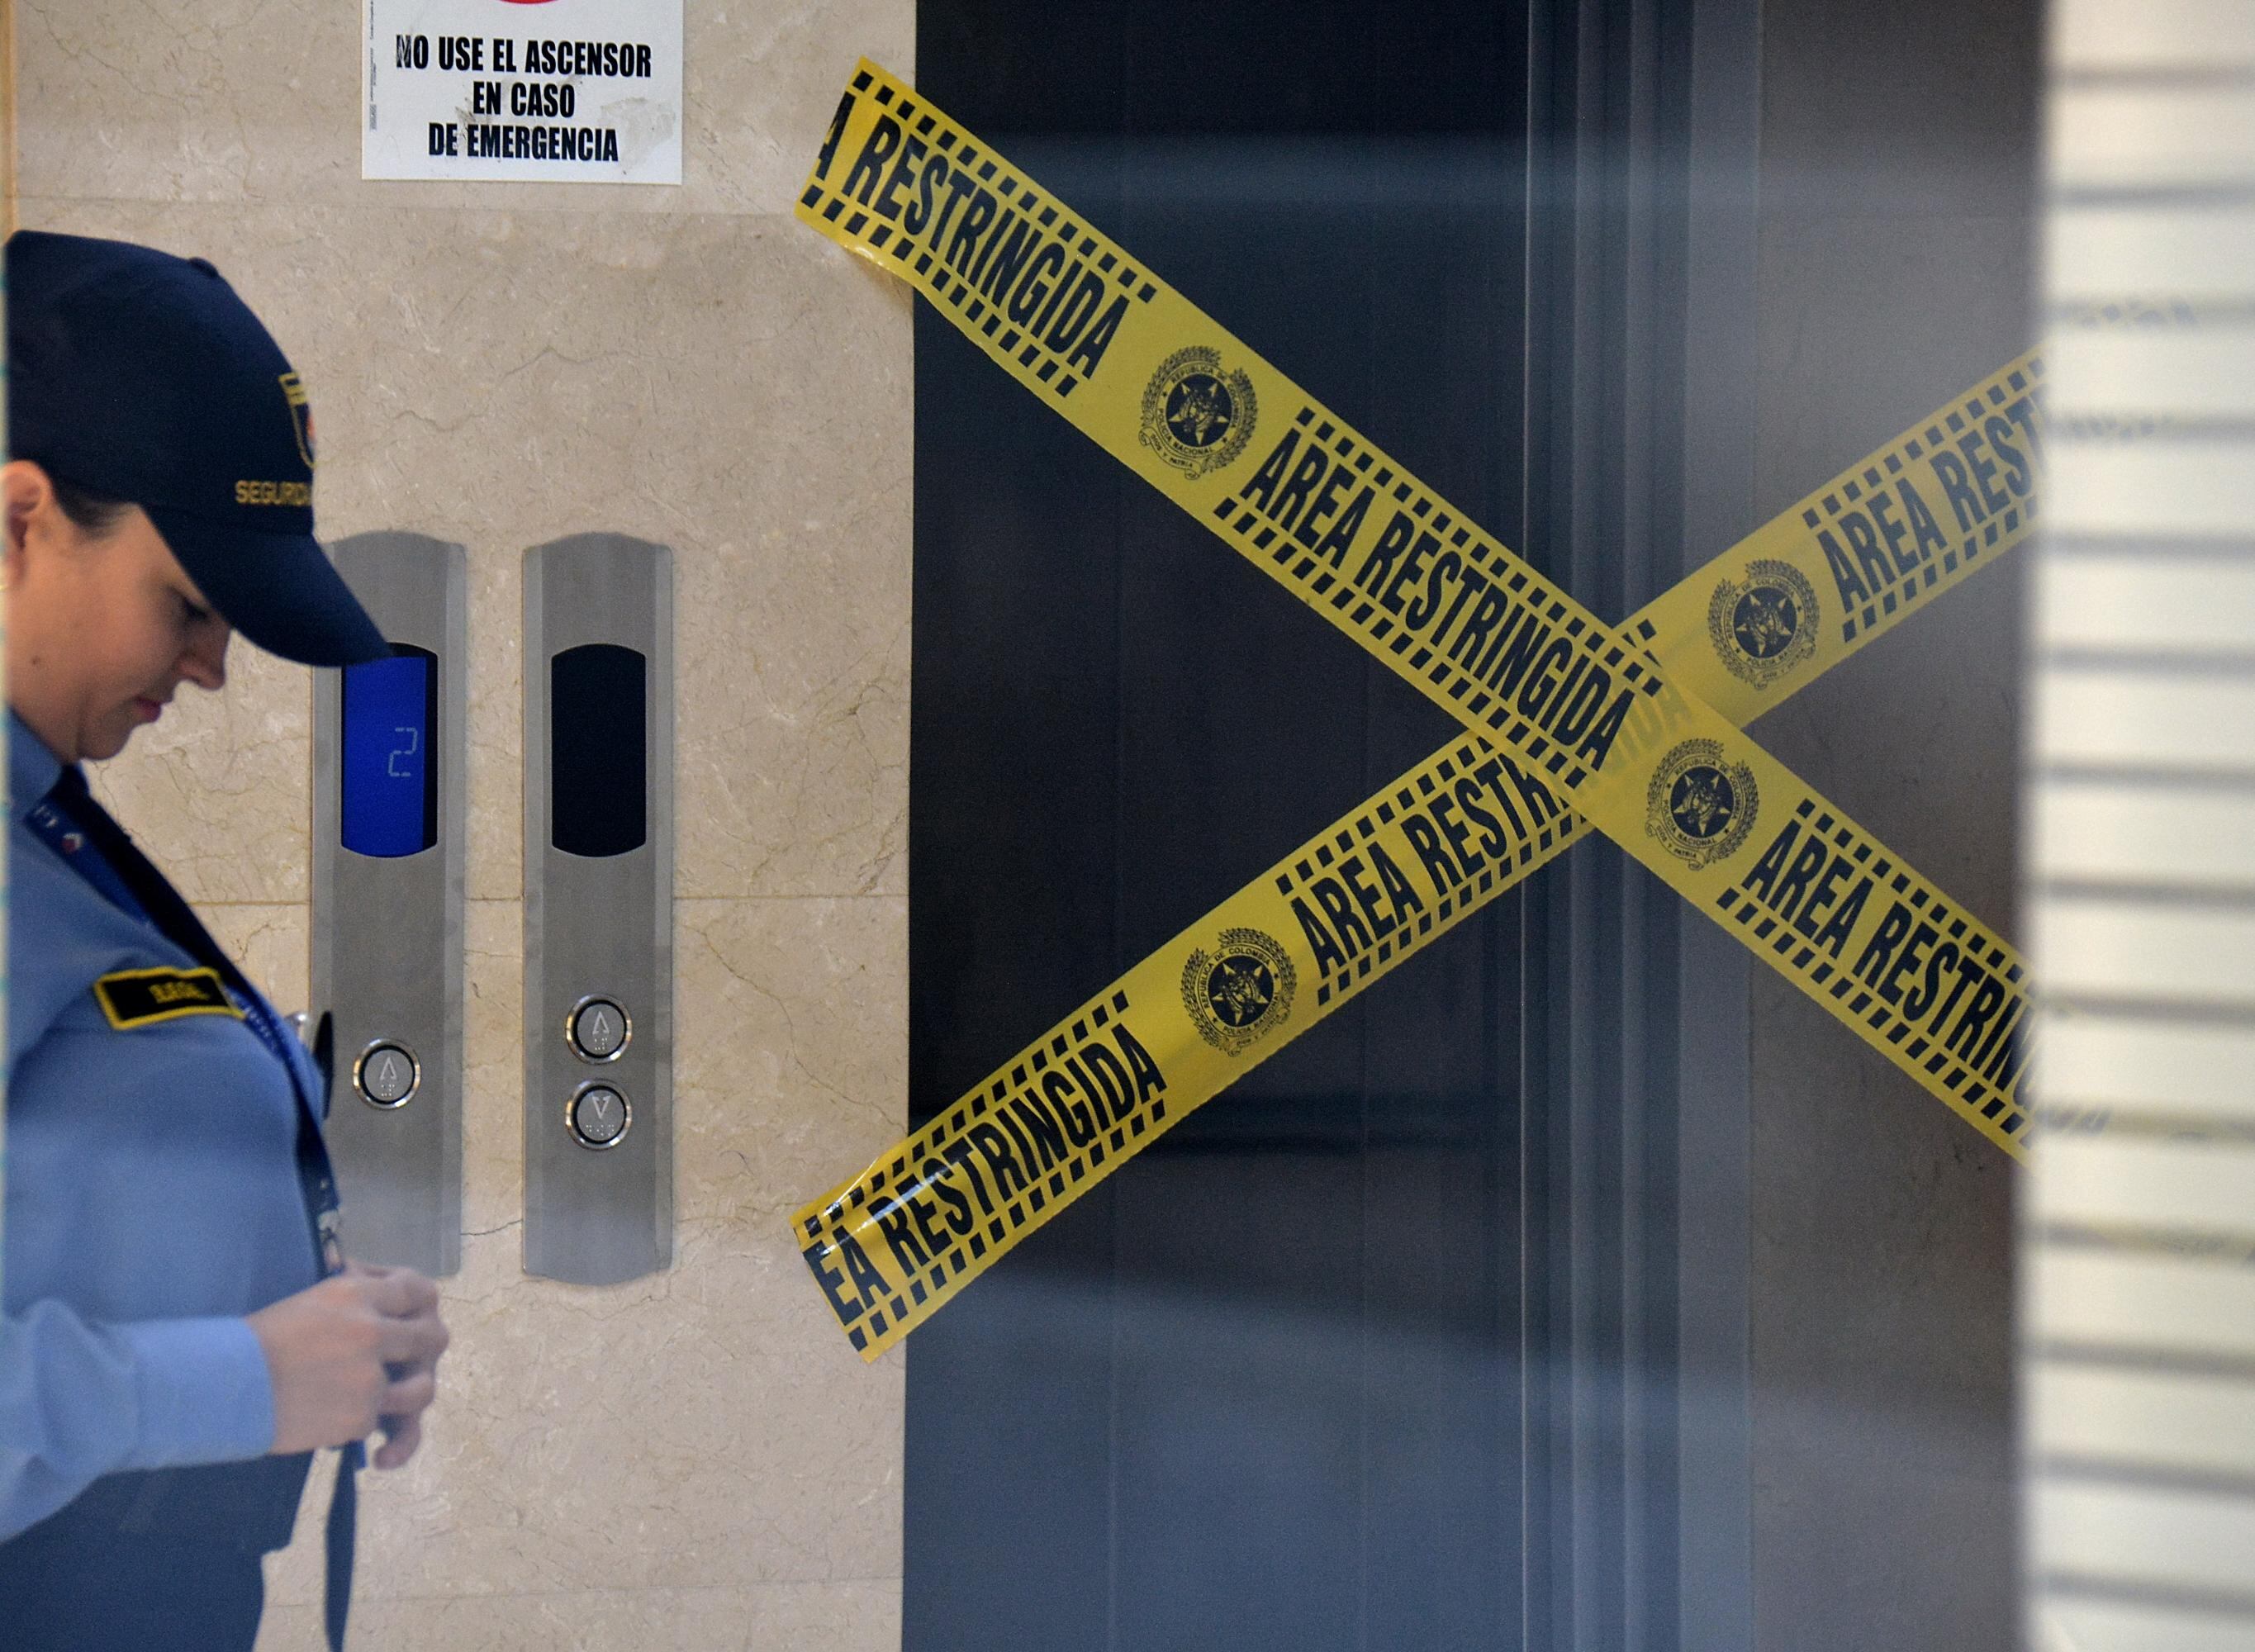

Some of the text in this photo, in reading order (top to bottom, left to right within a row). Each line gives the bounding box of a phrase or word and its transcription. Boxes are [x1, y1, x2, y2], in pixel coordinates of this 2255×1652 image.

[396, 34, 652, 78] NO USE EL ASCENSOR
[472, 80, 576, 118] EN CASO
[428, 122, 620, 162] DE EMERGENCIA
[841, 113, 1131, 380] RESTRINGIDA
[1239, 427, 1635, 772] AREA RESTRINGIDA
[1816, 477, 1948, 615] AREA
[387, 727, 418, 777] 2
[1290, 752, 1569, 980] AREA RESTR
[1740, 817, 1875, 961] AREA
[1199, 947, 1270, 1009] REPUBLICA DE COLOMBIA
[866, 1022, 1168, 1279] RESTRINGIDA
